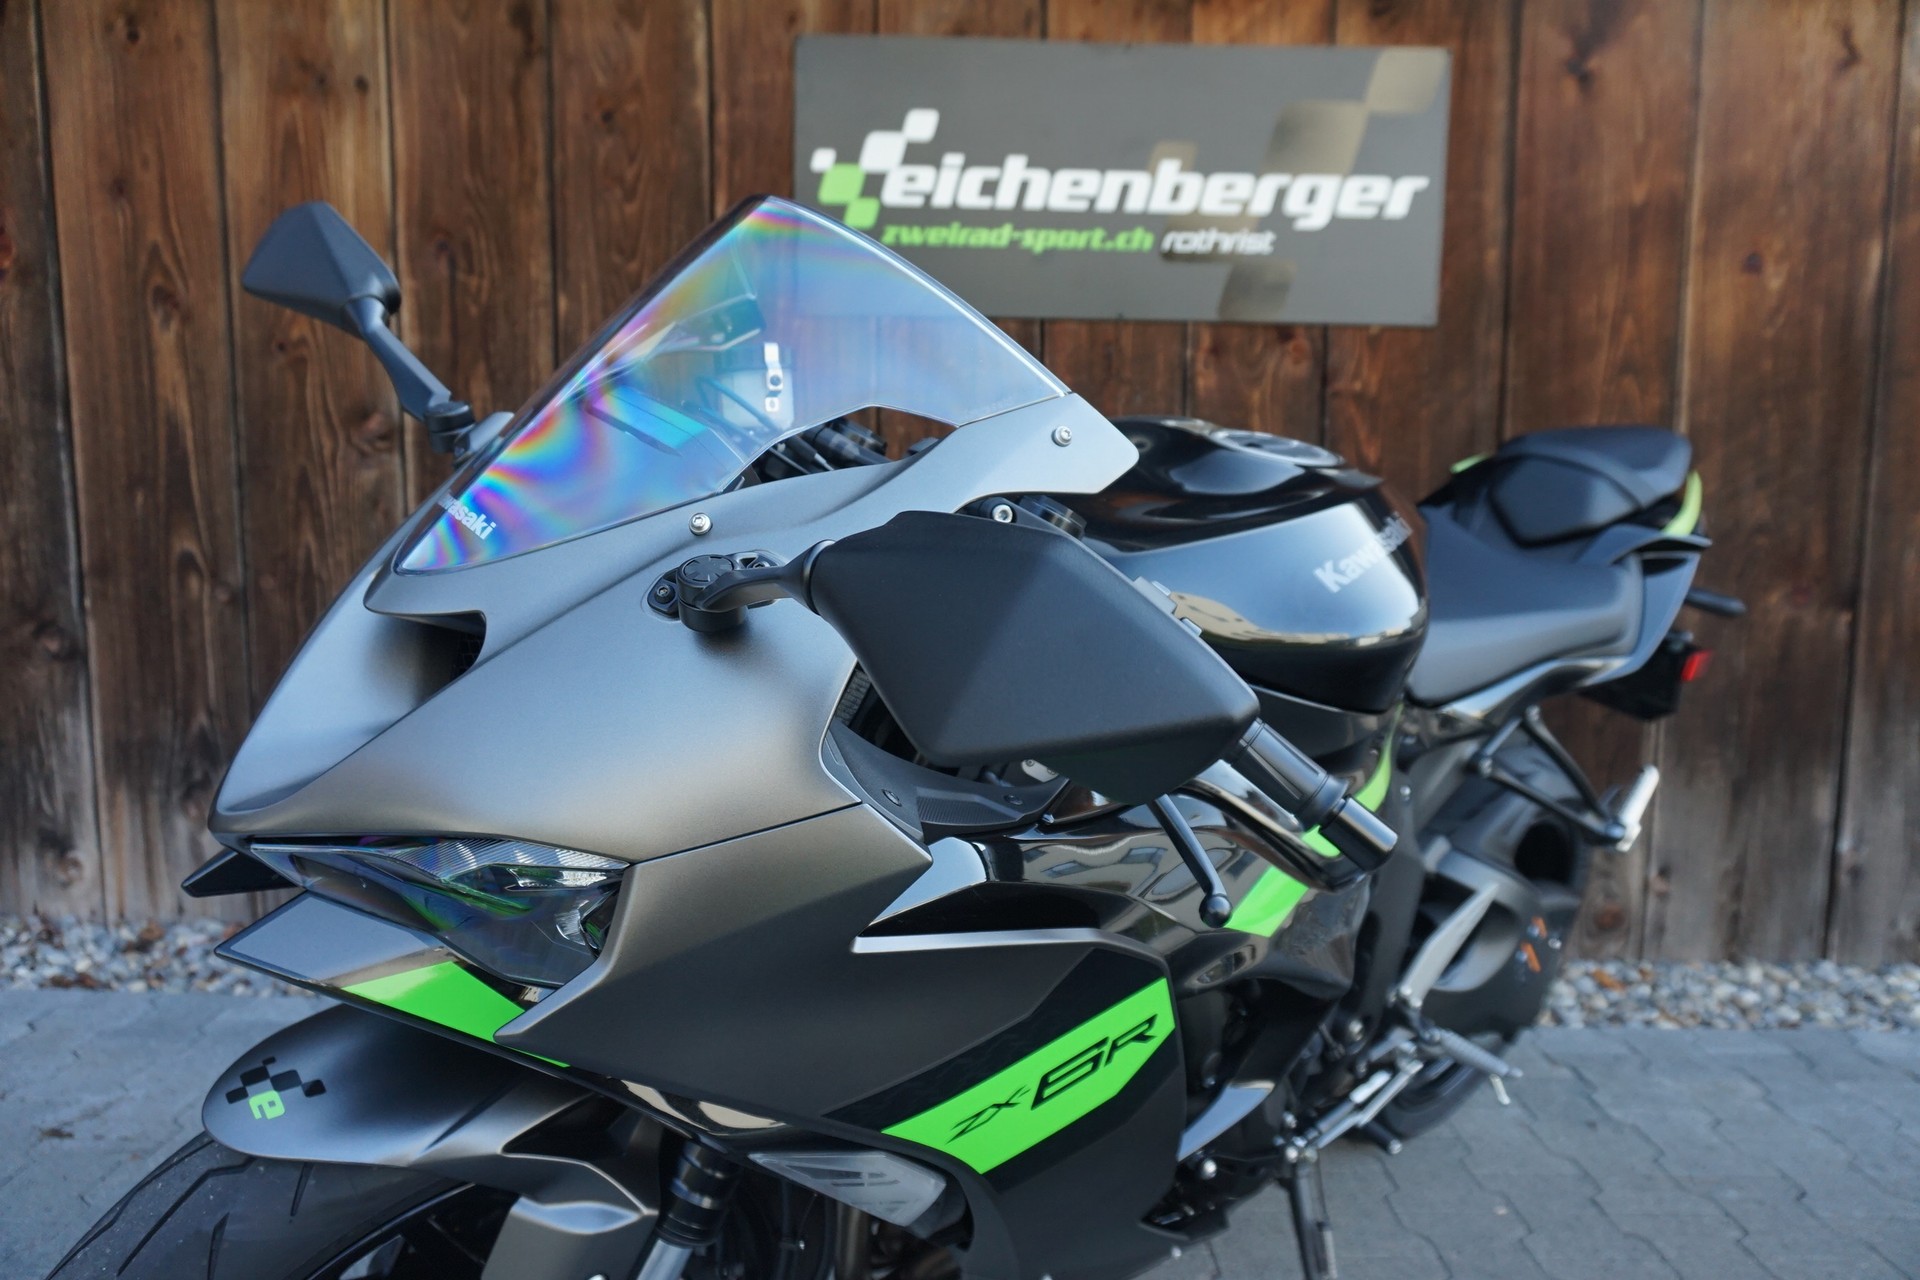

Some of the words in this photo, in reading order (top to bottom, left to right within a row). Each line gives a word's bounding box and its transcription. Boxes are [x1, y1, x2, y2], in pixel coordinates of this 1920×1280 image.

[881, 153, 1429, 231] eichenberger
[881, 221, 1154, 254] zweirad-sport.ch
[1160, 227, 1277, 255] rothrist
